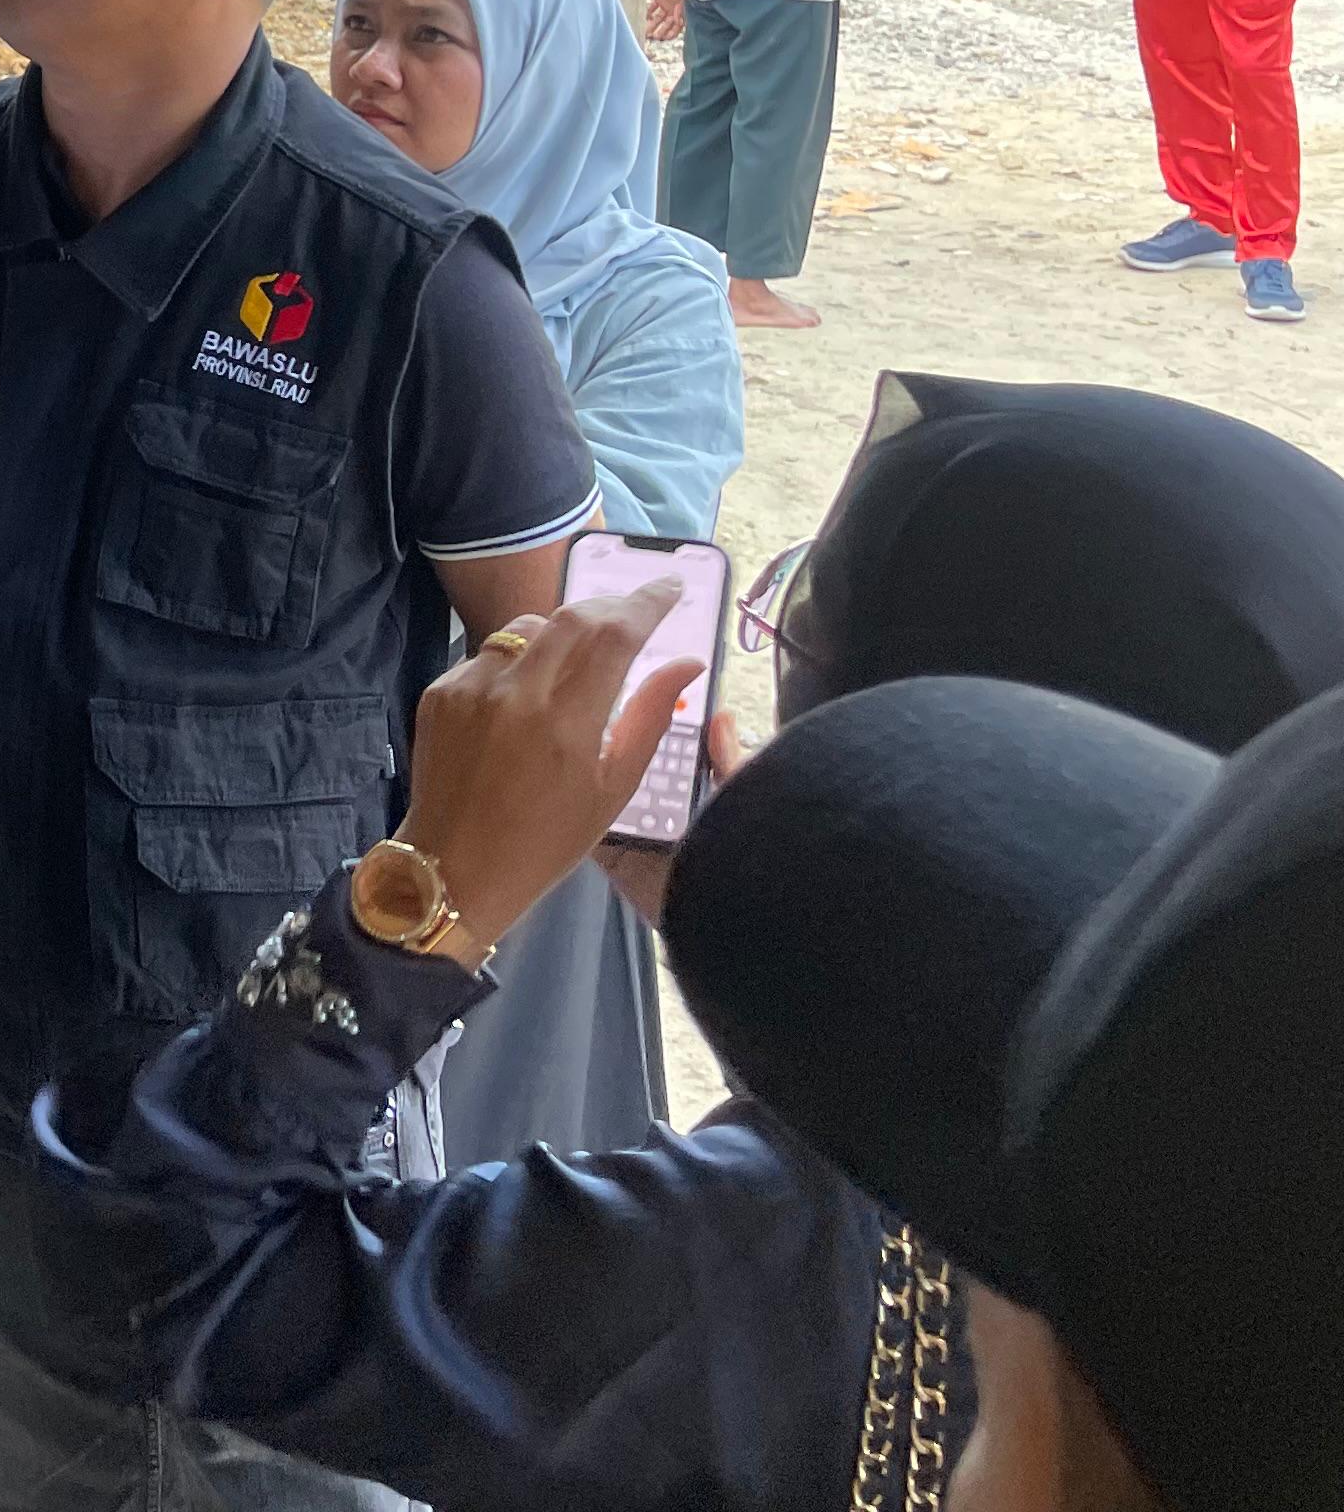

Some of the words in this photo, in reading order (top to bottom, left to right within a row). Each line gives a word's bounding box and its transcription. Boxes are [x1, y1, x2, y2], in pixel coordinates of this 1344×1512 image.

[192, 352, 268, 390] PROVINSI
[270, 377, 312, 404] RIAU
[200, 330, 319, 384] BAWASLU
